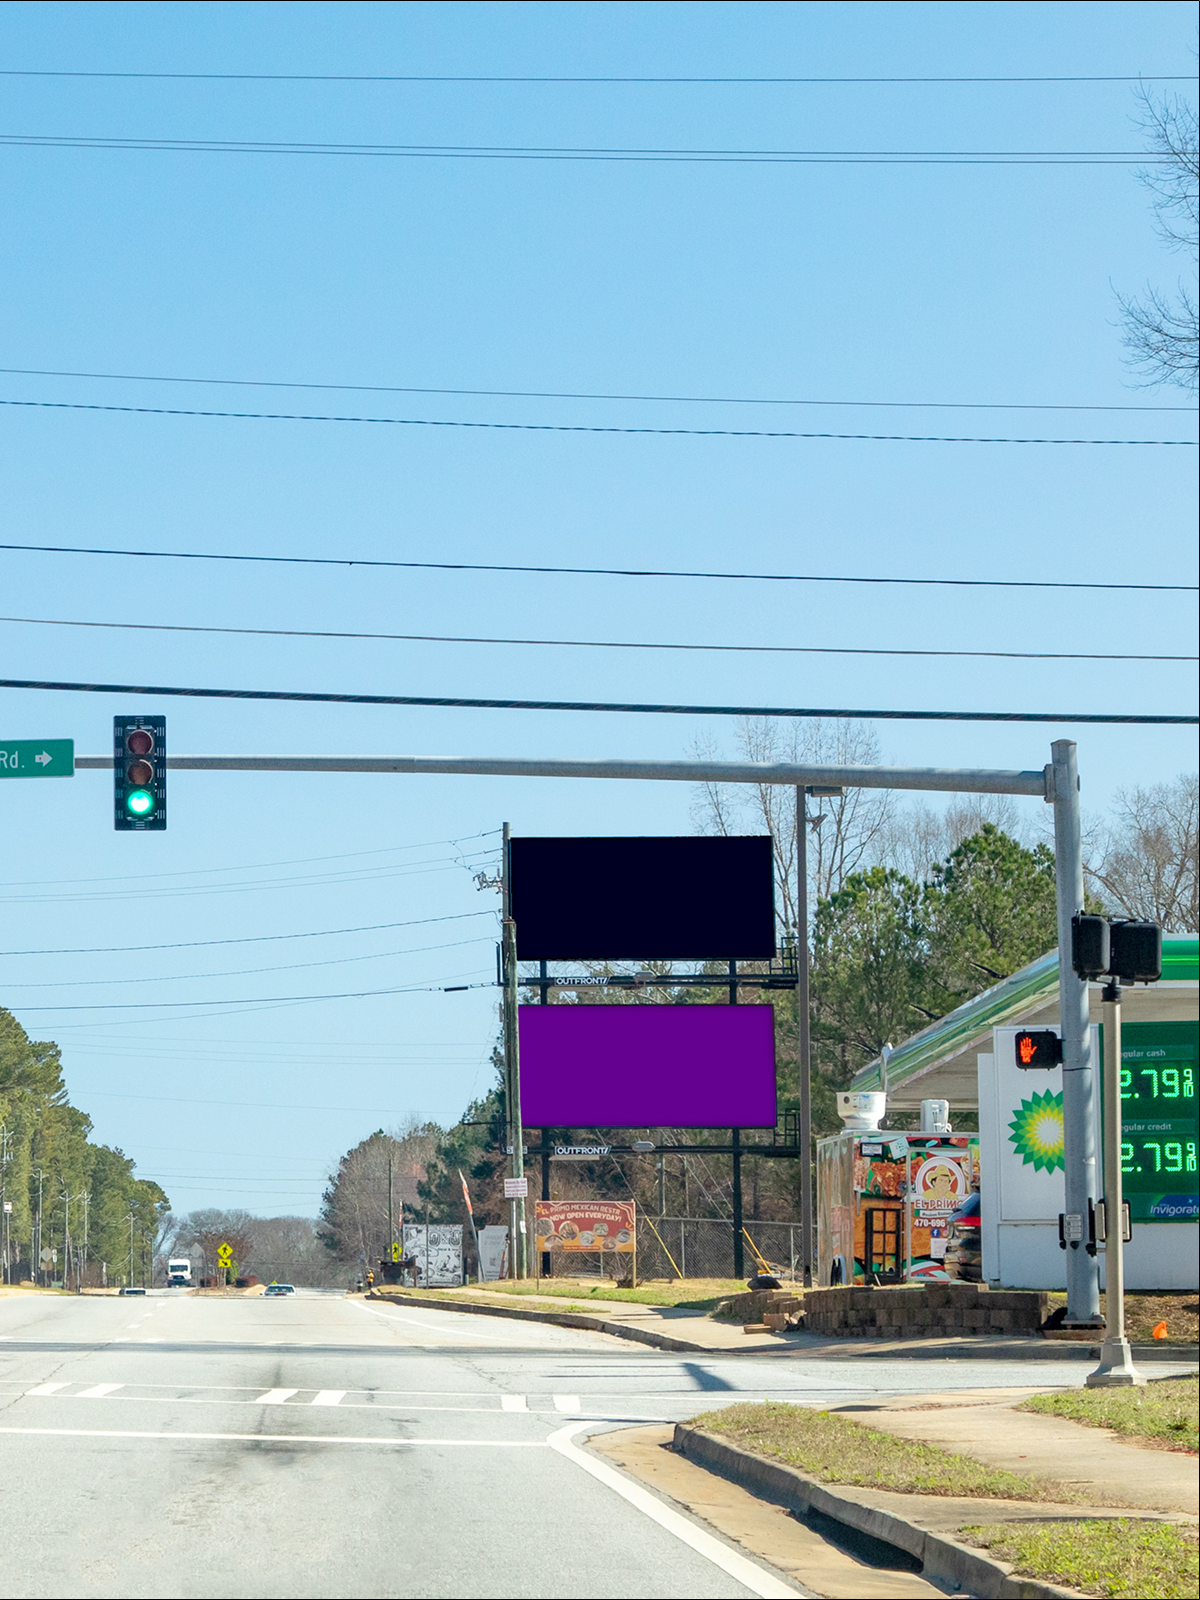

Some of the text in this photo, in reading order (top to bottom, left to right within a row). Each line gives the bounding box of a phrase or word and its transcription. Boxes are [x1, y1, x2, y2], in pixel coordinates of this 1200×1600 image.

[1146, 1049, 1166, 1057] cash
[1119, 1069, 1180, 1098] 2.79
[1147, 1121, 1171, 1131] credit
[1120, 1143, 1182, 1172] 2.79
[915, 1199, 925, 1208] EL
[550, 1204, 570, 1213] PRIMO
[550, 1213, 565, 1221] NOW
[585, 1212, 622, 1222] EVERYDAY!
[914, 1219, 946, 1227] 470-696
